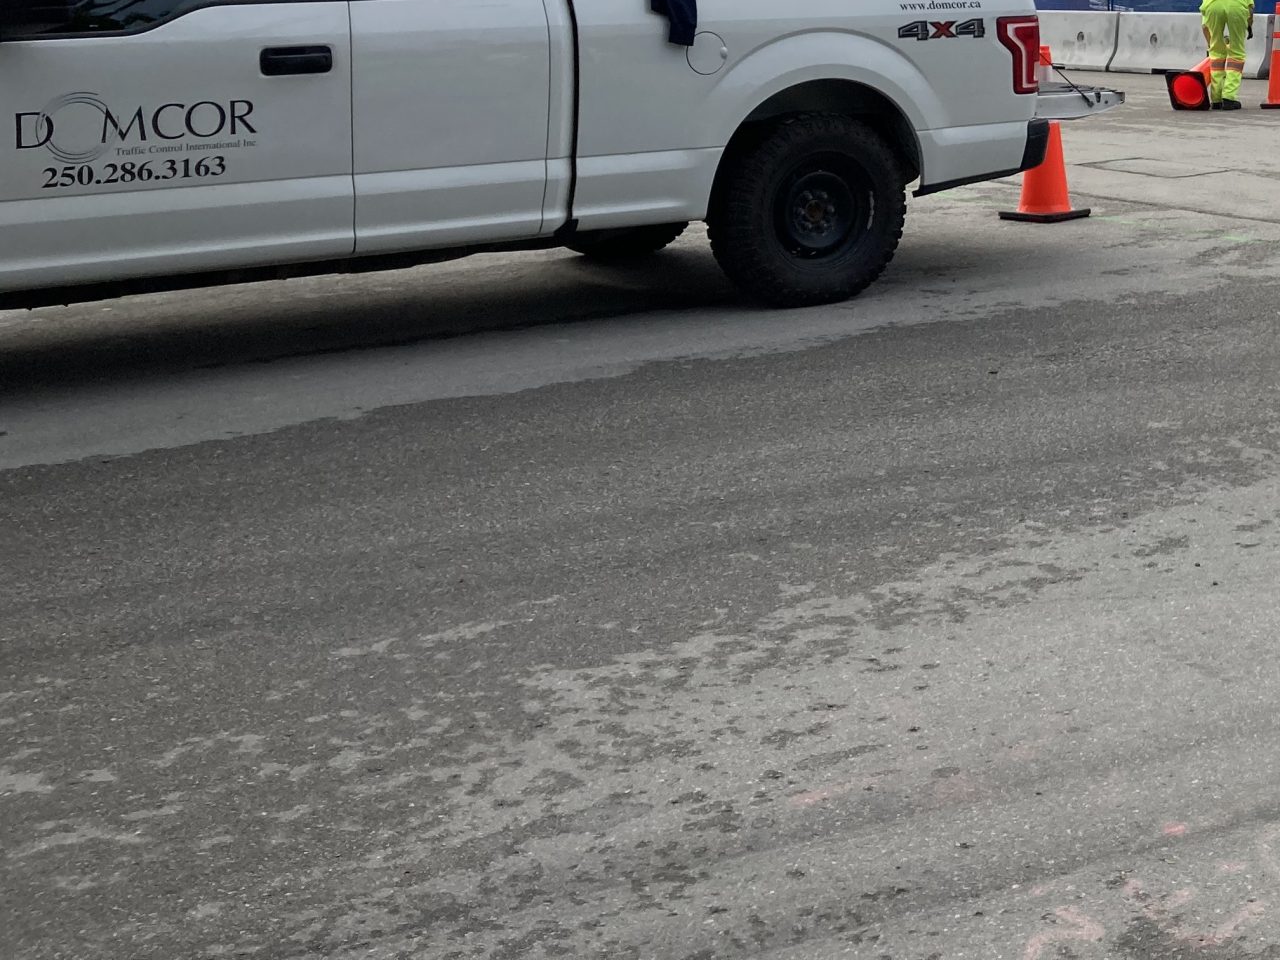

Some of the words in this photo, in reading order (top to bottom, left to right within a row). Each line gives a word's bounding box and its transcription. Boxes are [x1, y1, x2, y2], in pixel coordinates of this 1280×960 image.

[899, 0, 982, 11] www.domcor.ca
[15, 91, 258, 164] DOMCOR
[115, 146, 147, 156] Traffic
[148, 143, 183, 154] Control
[185, 140, 241, 151] International
[41, 155, 227, 188] 250.286.3163
